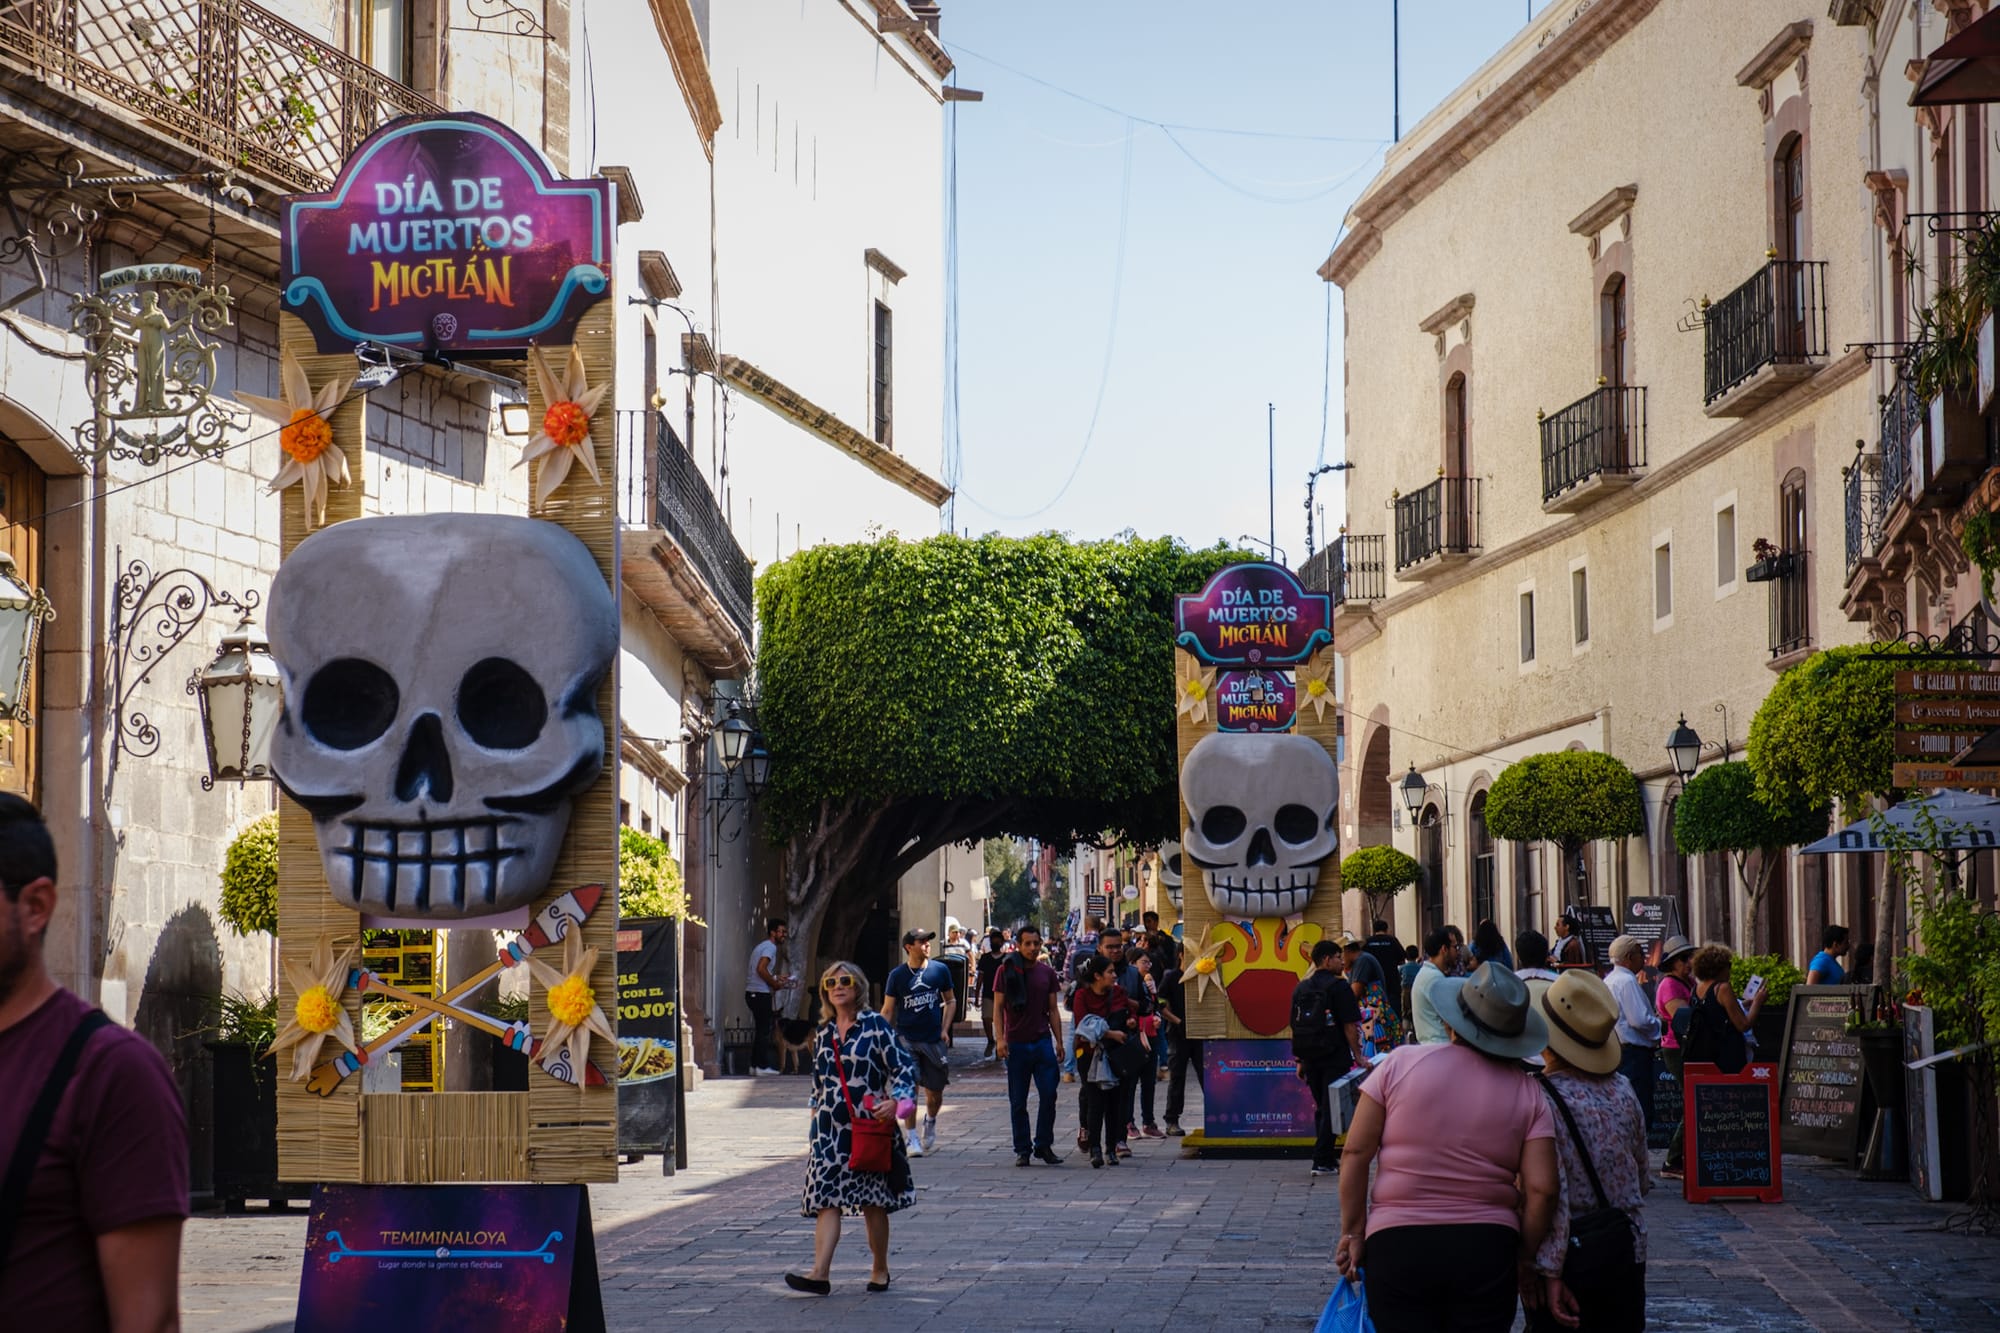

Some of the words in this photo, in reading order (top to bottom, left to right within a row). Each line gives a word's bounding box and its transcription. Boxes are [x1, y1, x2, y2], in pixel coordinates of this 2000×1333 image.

[375, 174, 443, 215] DÍA
[452, 177, 504, 211] DE
[347, 214, 534, 255] MUERTOS
[368, 255, 516, 312] MICTLÁN
[1221, 586, 1252, 605] DÍA
[1259, 589, 1284, 605] DE
[1207, 606, 1298, 623] MUERTOS
[1218, 622, 1289, 649] MICTLÁN
[1221, 692, 1284, 704] MUEOS
[622, 988, 647, 999] CON
[649, 987, 664, 997] EL
[380, 1231, 507, 1245] TEMIMINALOYA
[378, 1260, 400, 1270] Lugar
[401, 1260, 426, 1268] donde
[427, 1260, 435, 1268] la
[436, 1261, 458, 1271] gente
[470, 1260, 503, 1269] flechada
